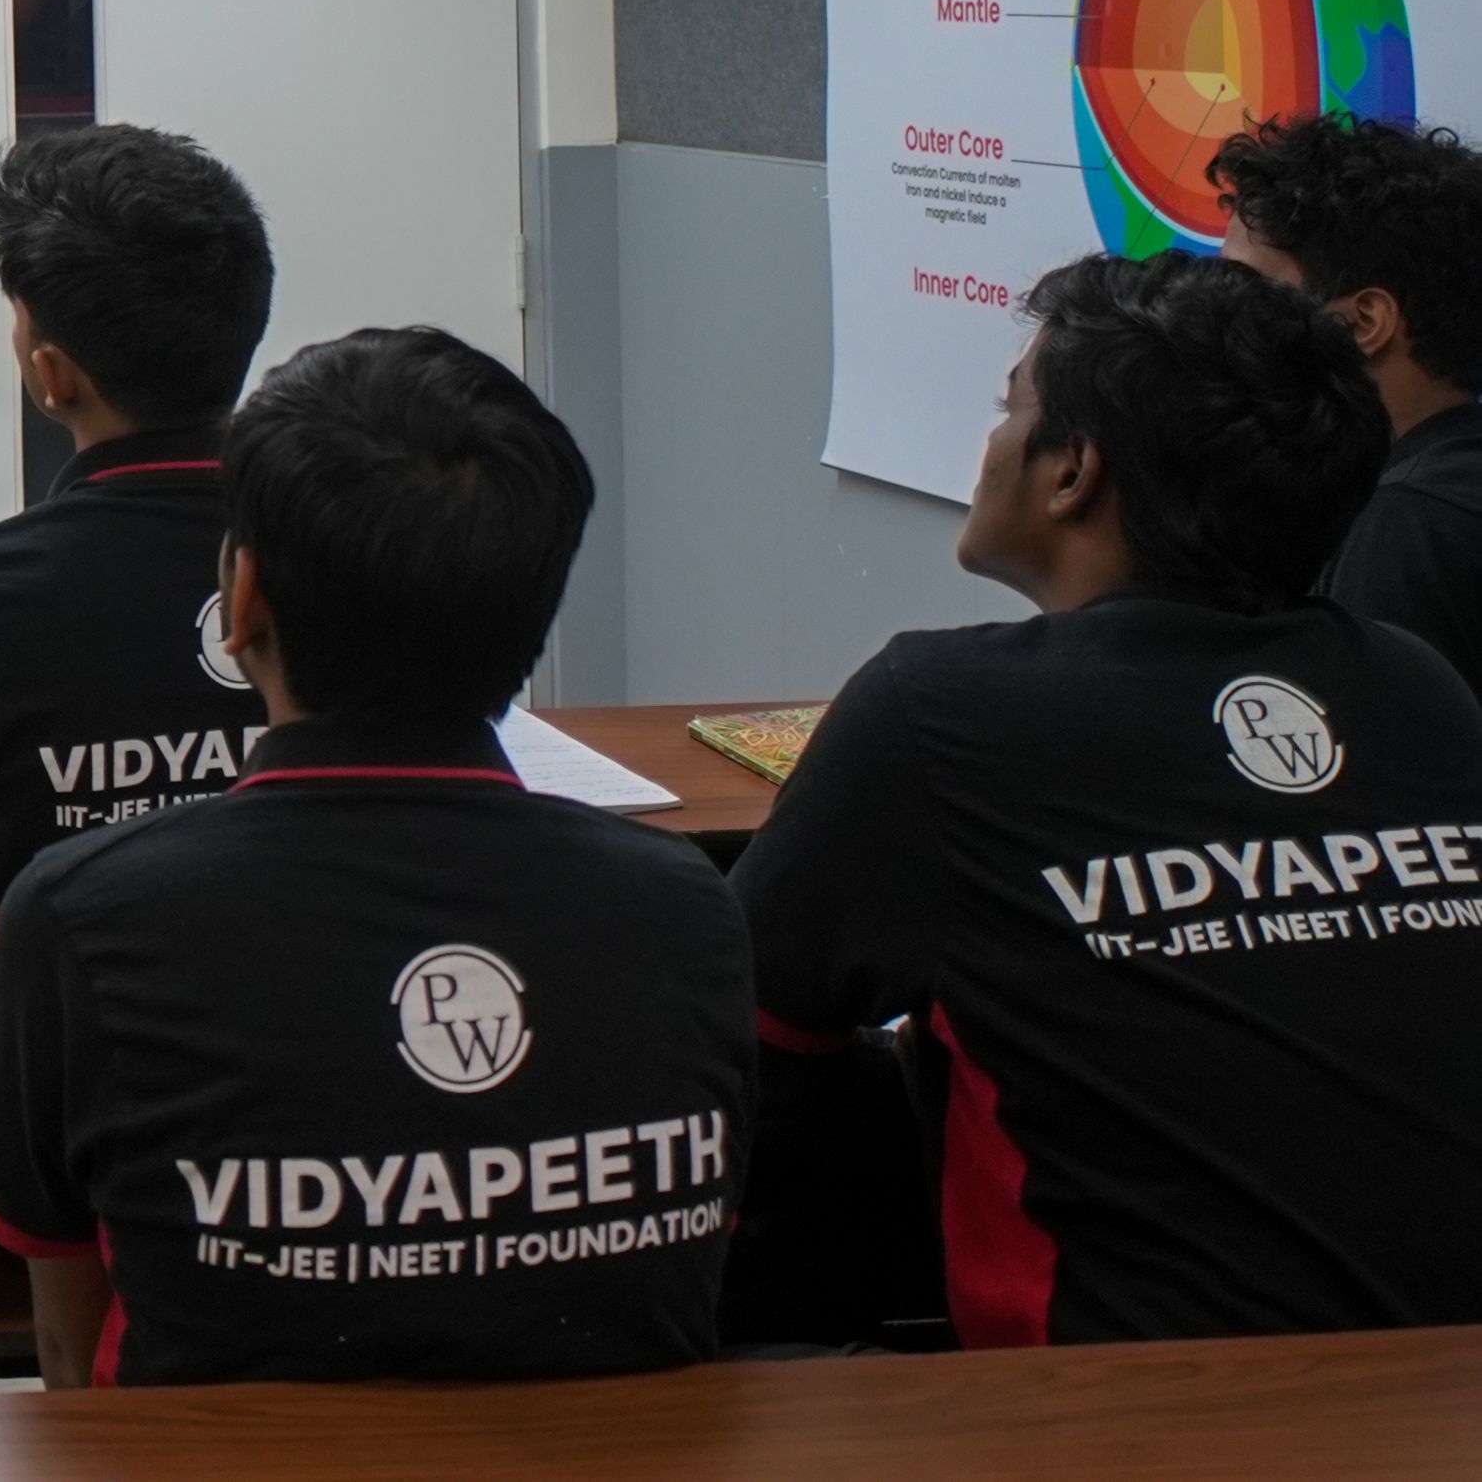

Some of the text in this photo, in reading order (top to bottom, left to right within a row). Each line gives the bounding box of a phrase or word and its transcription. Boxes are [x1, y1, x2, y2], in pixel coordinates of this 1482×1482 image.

[905, 125, 1003, 160] Outer Core
[891, 161, 1021, 189] Convection Currents of molten
[923, 186, 940, 200] and
[941, 186, 967, 203] nickel
[968, 190, 998, 207] induce
[999, 196, 1006, 208] a
[925, 206, 987, 226] magnetic field
[914, 267, 1008, 307] Inner Core
[1258, 910, 1350, 943] NEET
[176, 1110, 724, 1229] VIDYAPEETH
[197, 1235, 336, 1280] IIT-JEE
[369, 1240, 466, 1278] NEET
[496, 1198, 723, 1270] FOUNDATION
